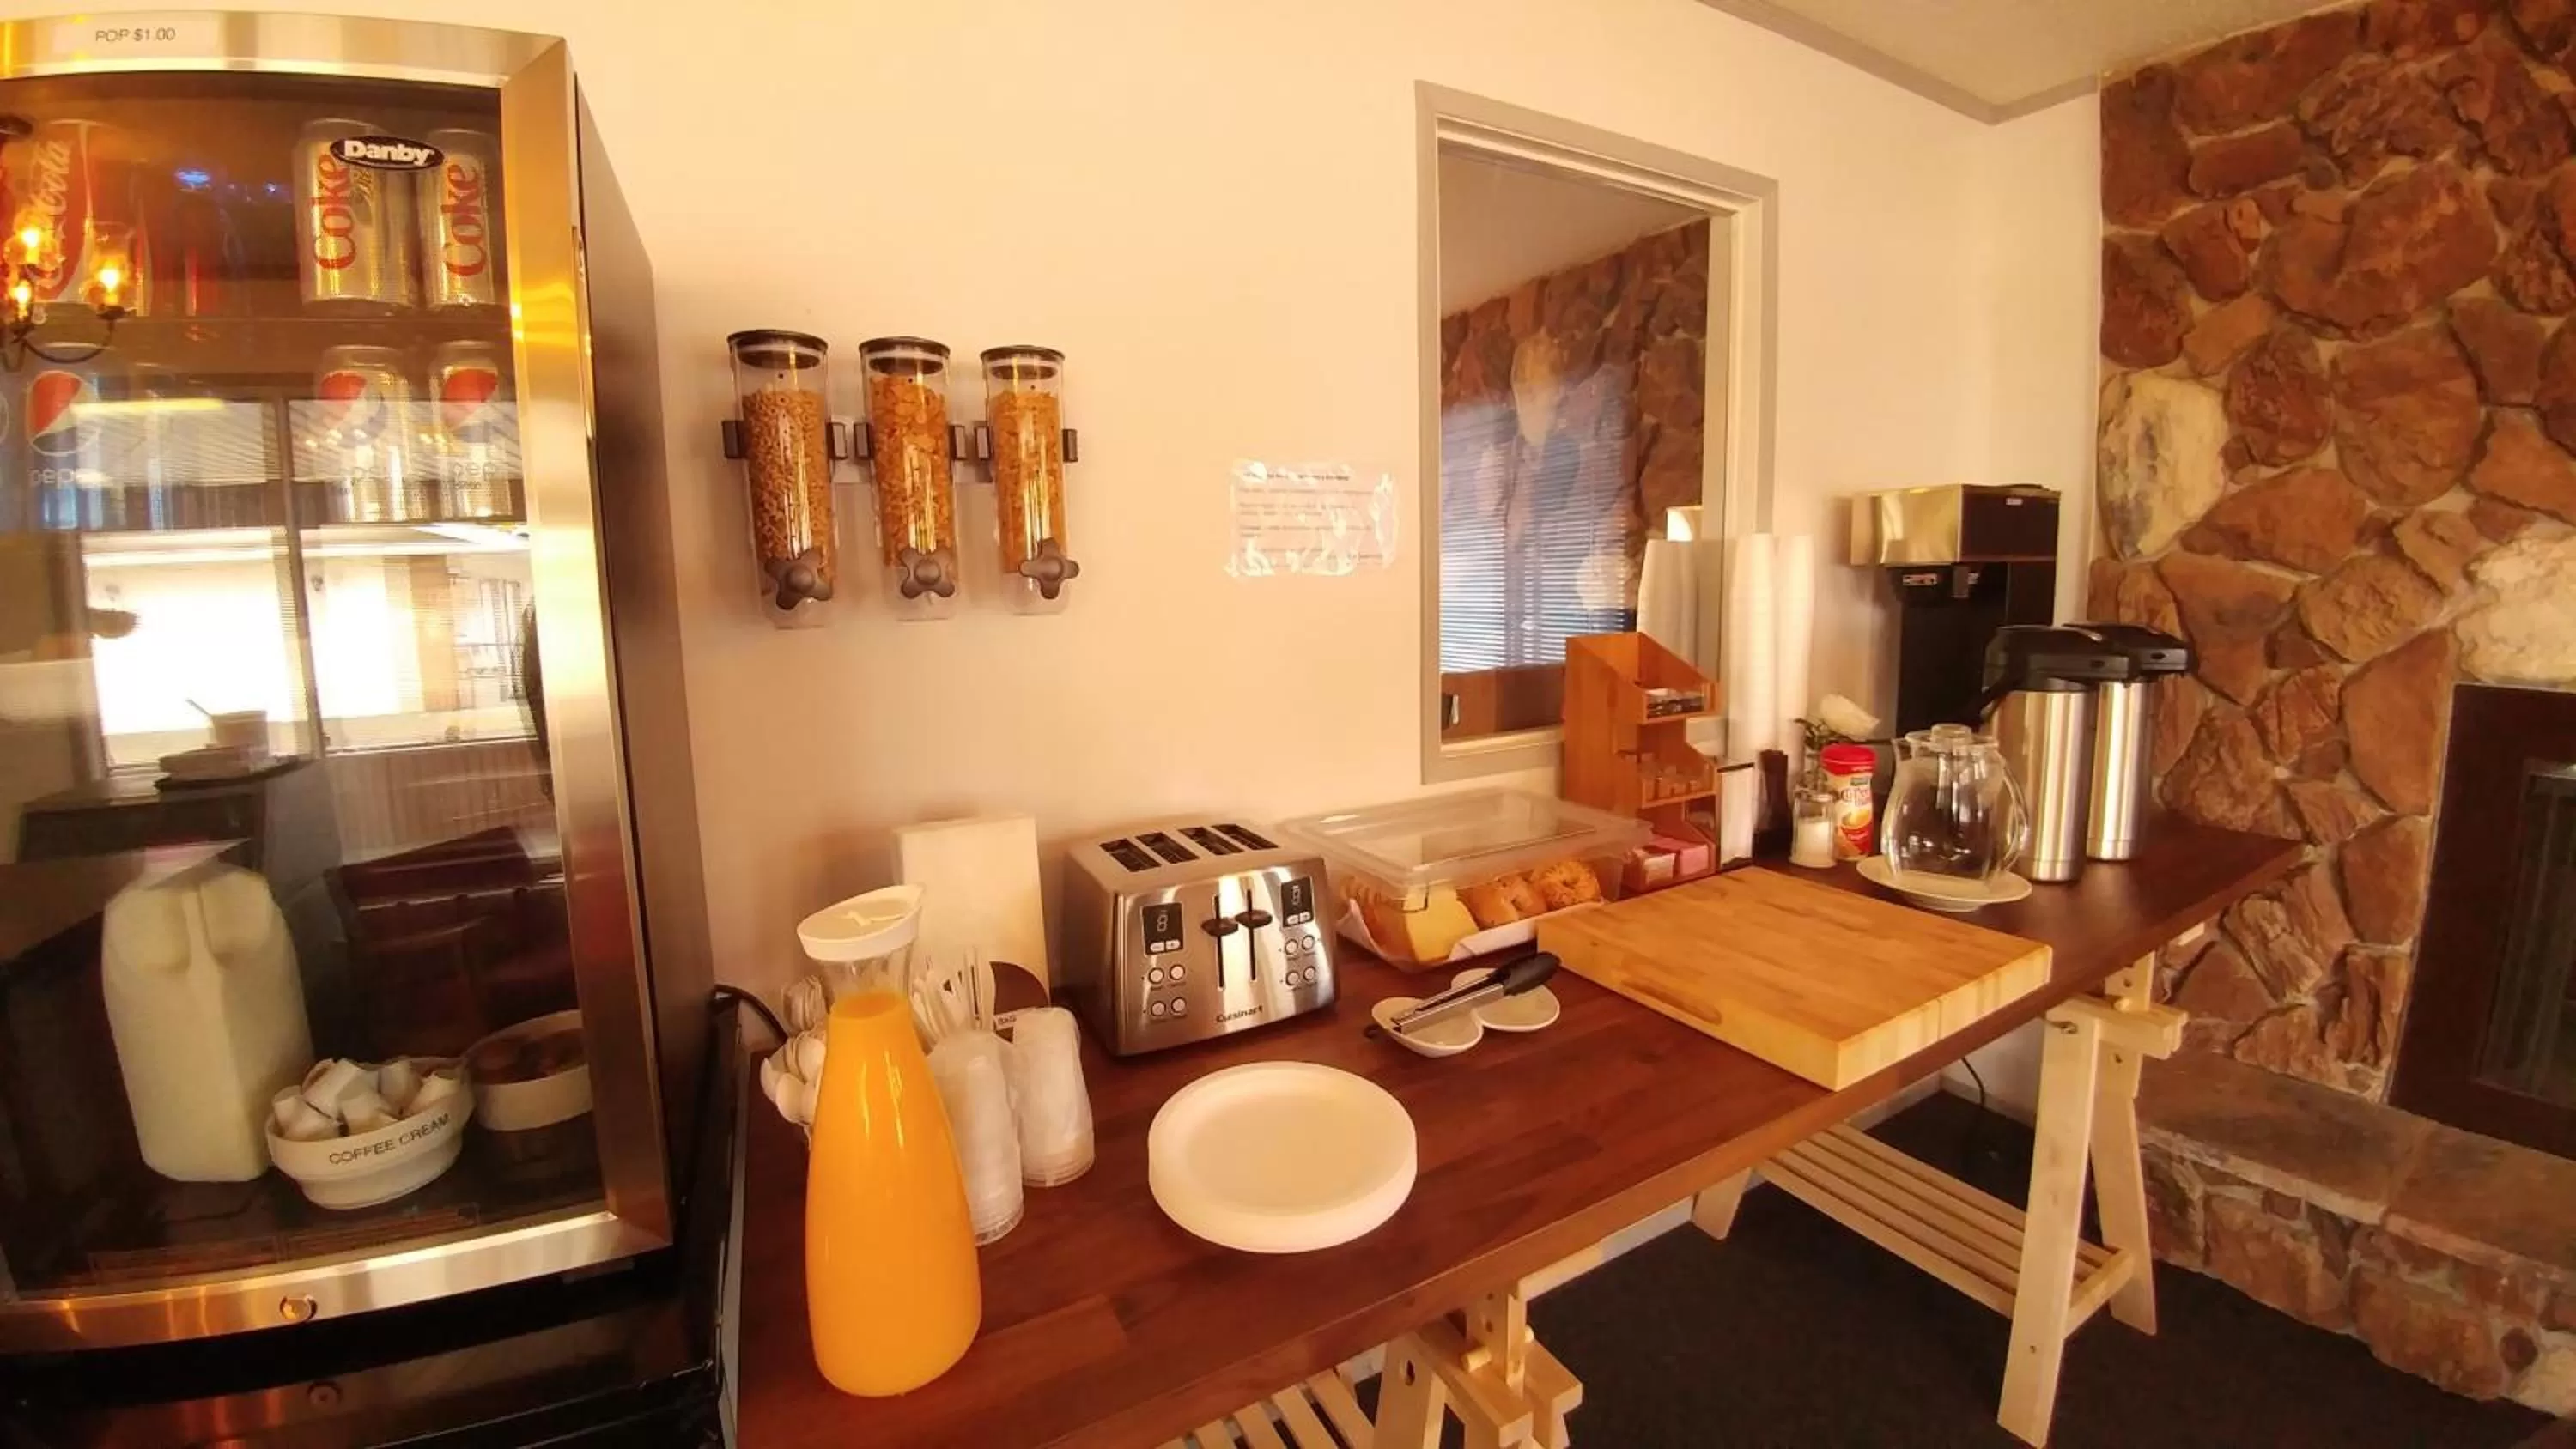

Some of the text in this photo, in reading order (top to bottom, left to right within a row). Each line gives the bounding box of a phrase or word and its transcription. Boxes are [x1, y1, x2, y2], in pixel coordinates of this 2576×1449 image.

[95, 27, 177, 42] POP $1.00
[343, 139, 434, 167] Danby
[309, 154, 357, 270] Coke
[440, 164, 487, 276] Coke
[1215, 1004, 1264, 1023] Cuisinart
[329, 1113, 450, 1165] COFFEE CREAM
